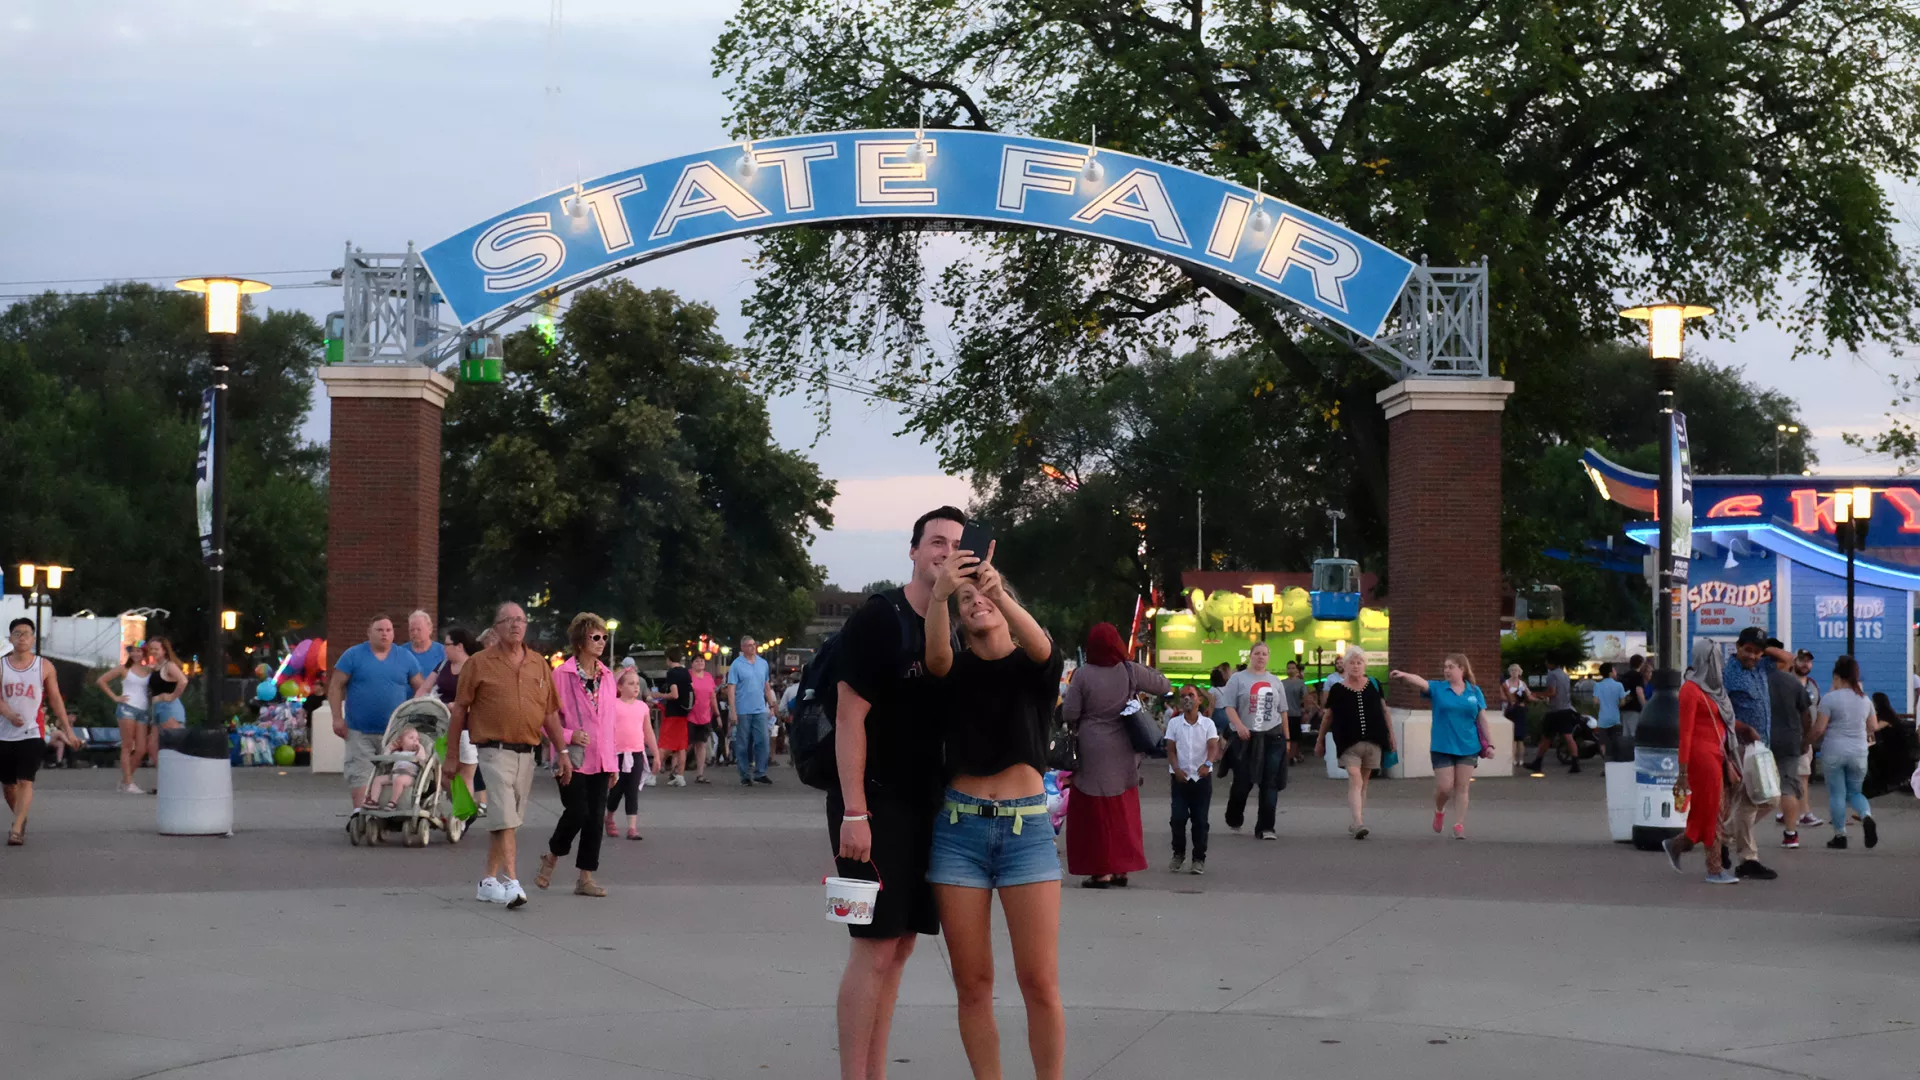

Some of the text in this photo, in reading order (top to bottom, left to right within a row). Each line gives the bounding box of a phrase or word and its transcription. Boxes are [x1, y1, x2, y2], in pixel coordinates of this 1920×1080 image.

[472, 139, 1362, 314] STATE FAIR
[1688, 580, 1771, 611] SKYRIDE
[1232, 598, 1283, 614] FRD
[1223, 615, 1295, 633] PICKLES
[1819, 621, 1882, 639] TICETS
[4, 682, 35, 700] USA
[1248, 695, 1258, 714] THE
[1264, 696, 1273, 721] FACE
